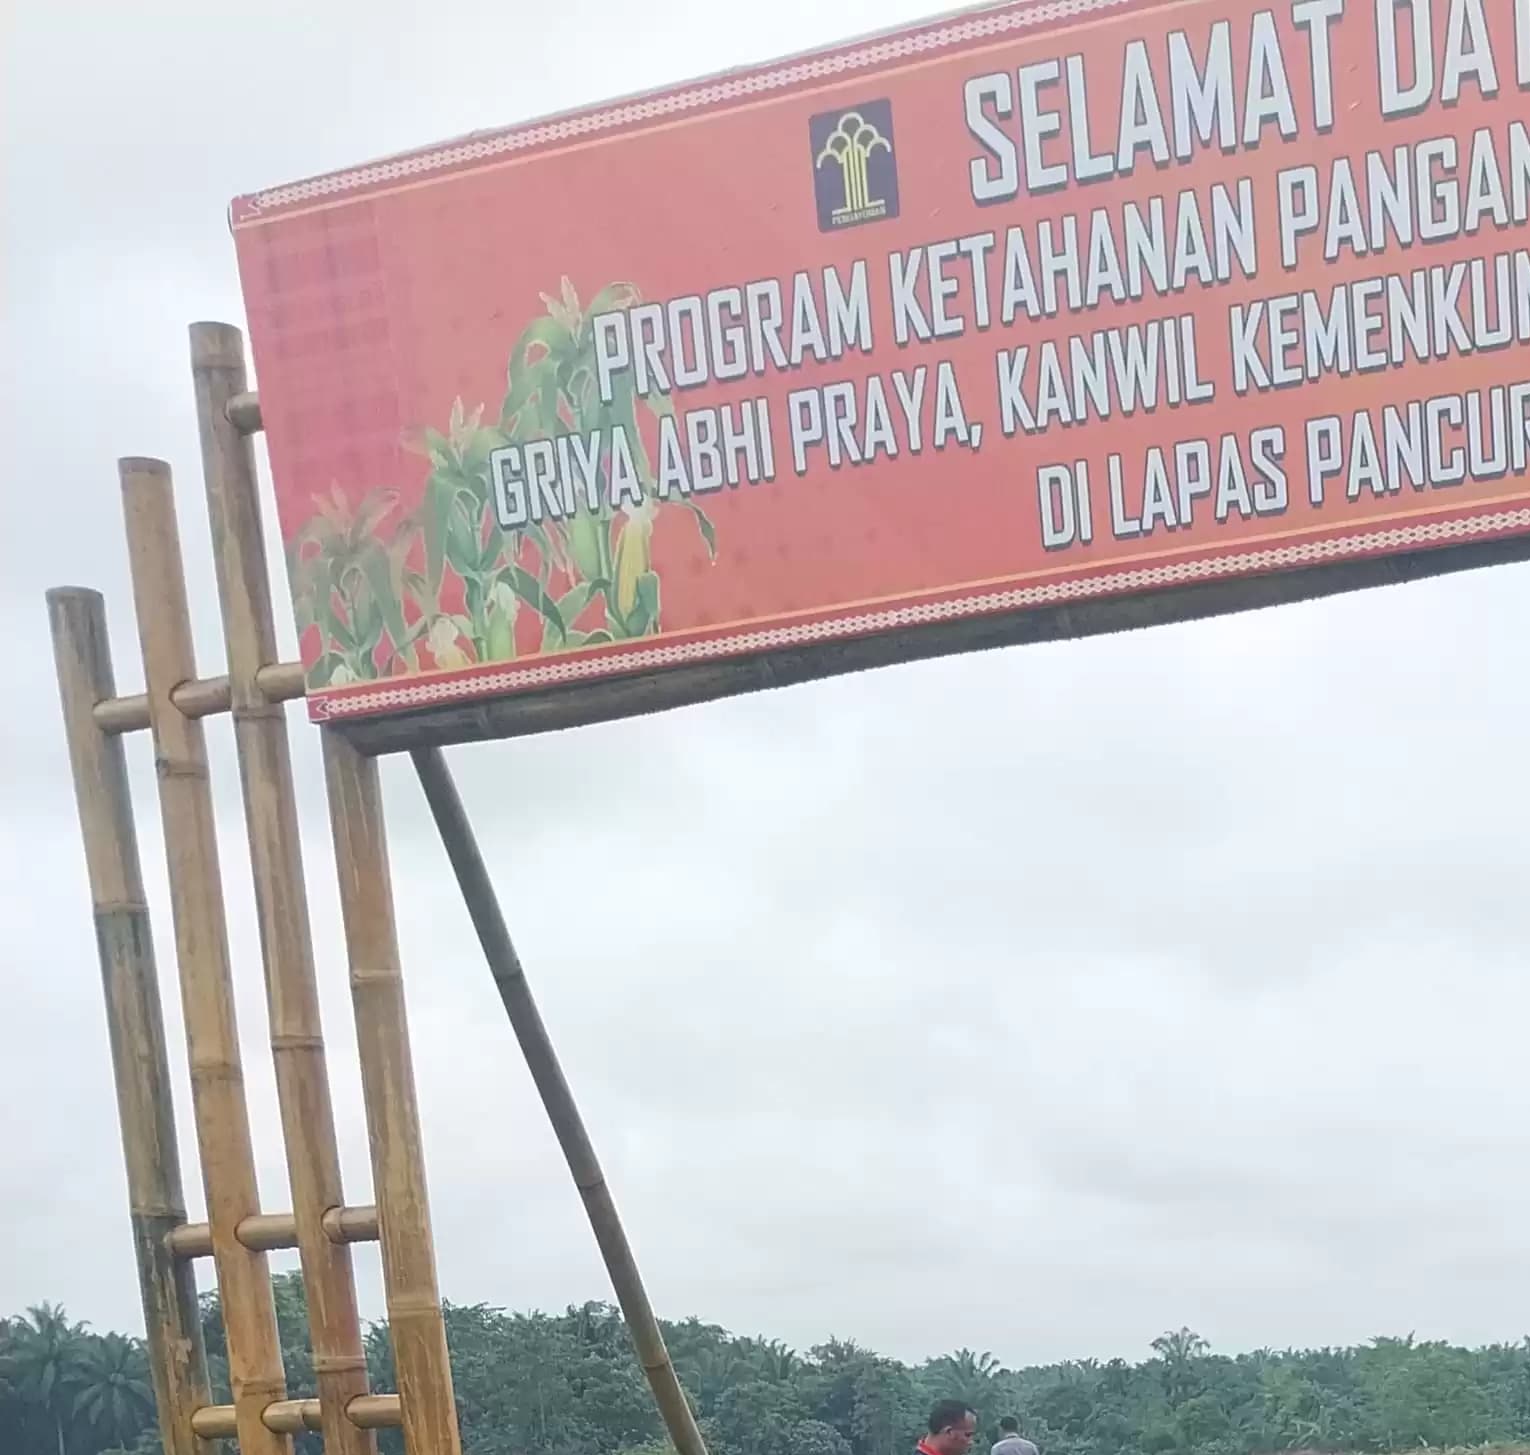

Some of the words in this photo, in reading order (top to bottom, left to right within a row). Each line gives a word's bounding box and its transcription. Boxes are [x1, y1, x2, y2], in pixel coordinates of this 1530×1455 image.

[964, 0, 1345, 202] SELAMAT
[593, 260, 873, 403] PROGRAM
[889, 176, 1256, 346] KETAHANAN
[490, 425, 643, 530] GRIYA
[658, 398, 776, 500] ABHI
[788, 361, 982, 473] PRAYA,
[997, 313, 1215, 436] KANWIL
[1037, 460, 1092, 549] DI
[1109, 426, 1288, 537] LAPAS
